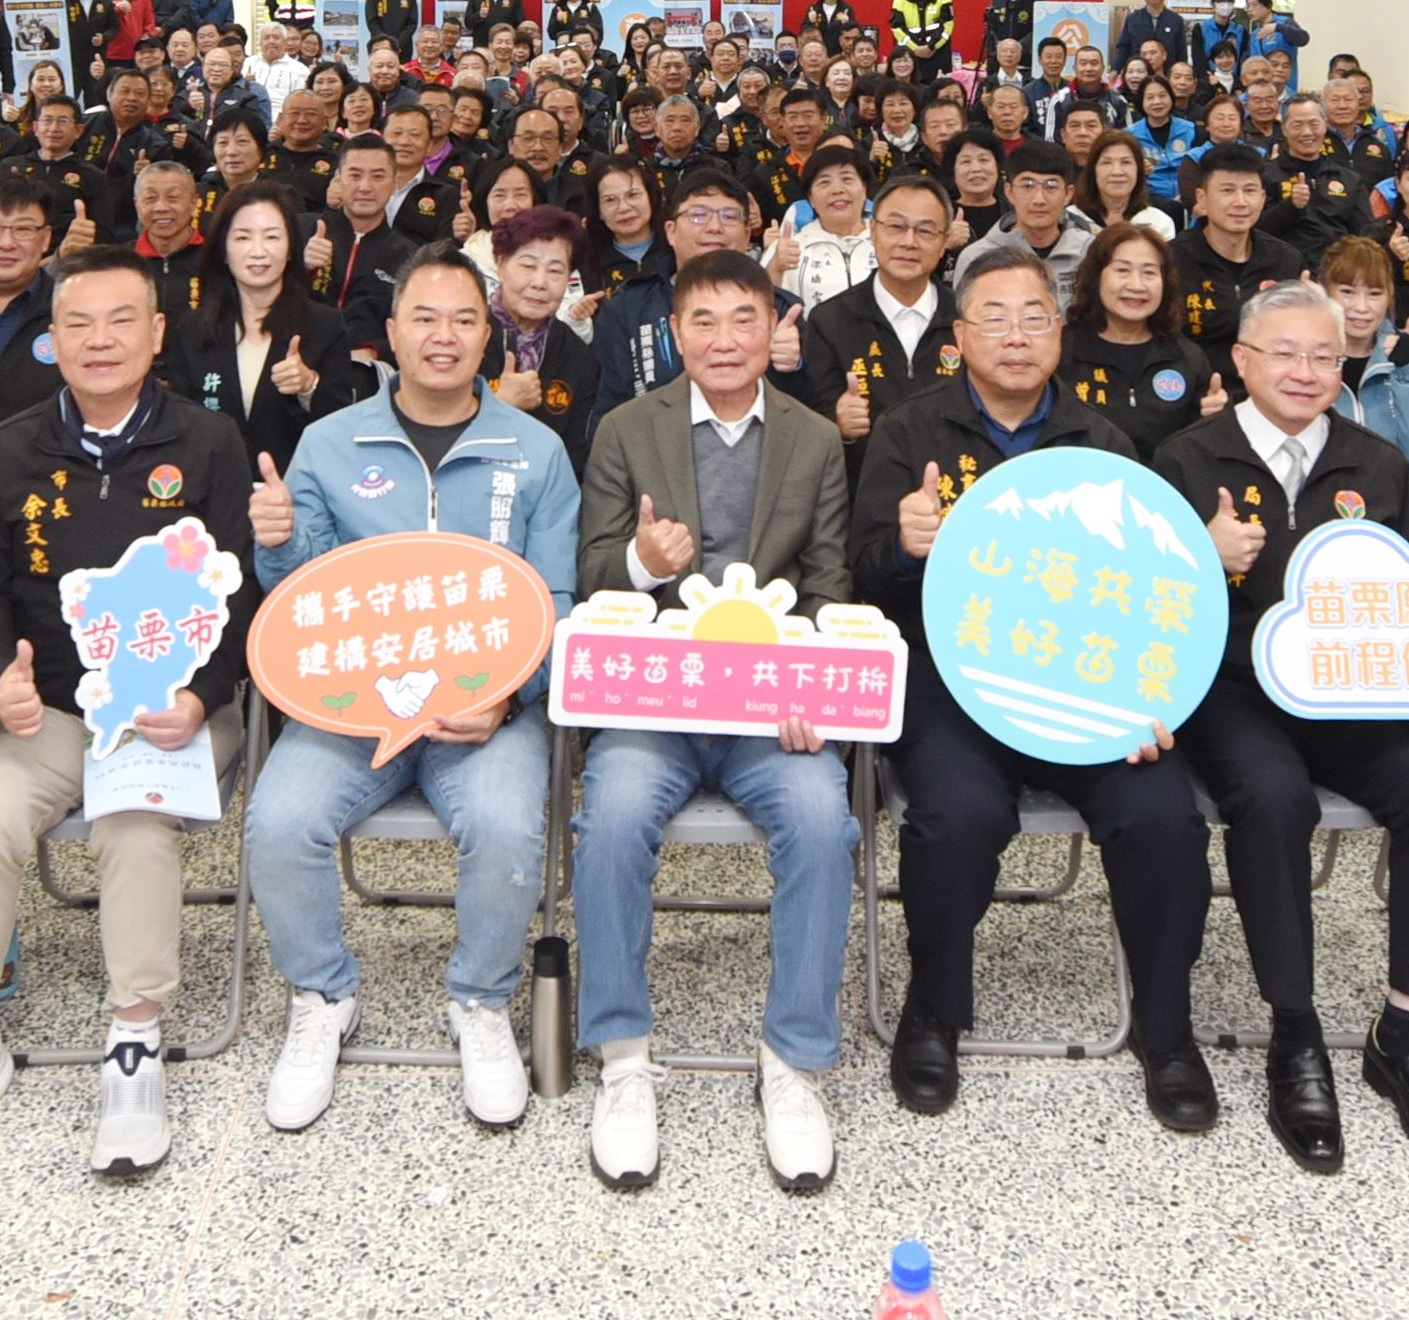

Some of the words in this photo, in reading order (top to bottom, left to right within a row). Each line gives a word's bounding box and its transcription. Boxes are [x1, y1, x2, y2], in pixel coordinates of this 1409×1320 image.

[50, 469, 73, 520] 市長
[22, 494, 50, 575] 余文忠
[291, 564, 509, 628] 攜手守護苗栗
[967, 538, 1199, 634] 山海共榮
[81, 607, 221, 661] 苗栗市
[295, 616, 511, 680] 建構安居城市
[953, 592, 1178, 705] 美好苗栗
[744, 699, 779, 716] kiung
[790, 701, 806, 715] ha
[852, 704, 887, 722] biang
